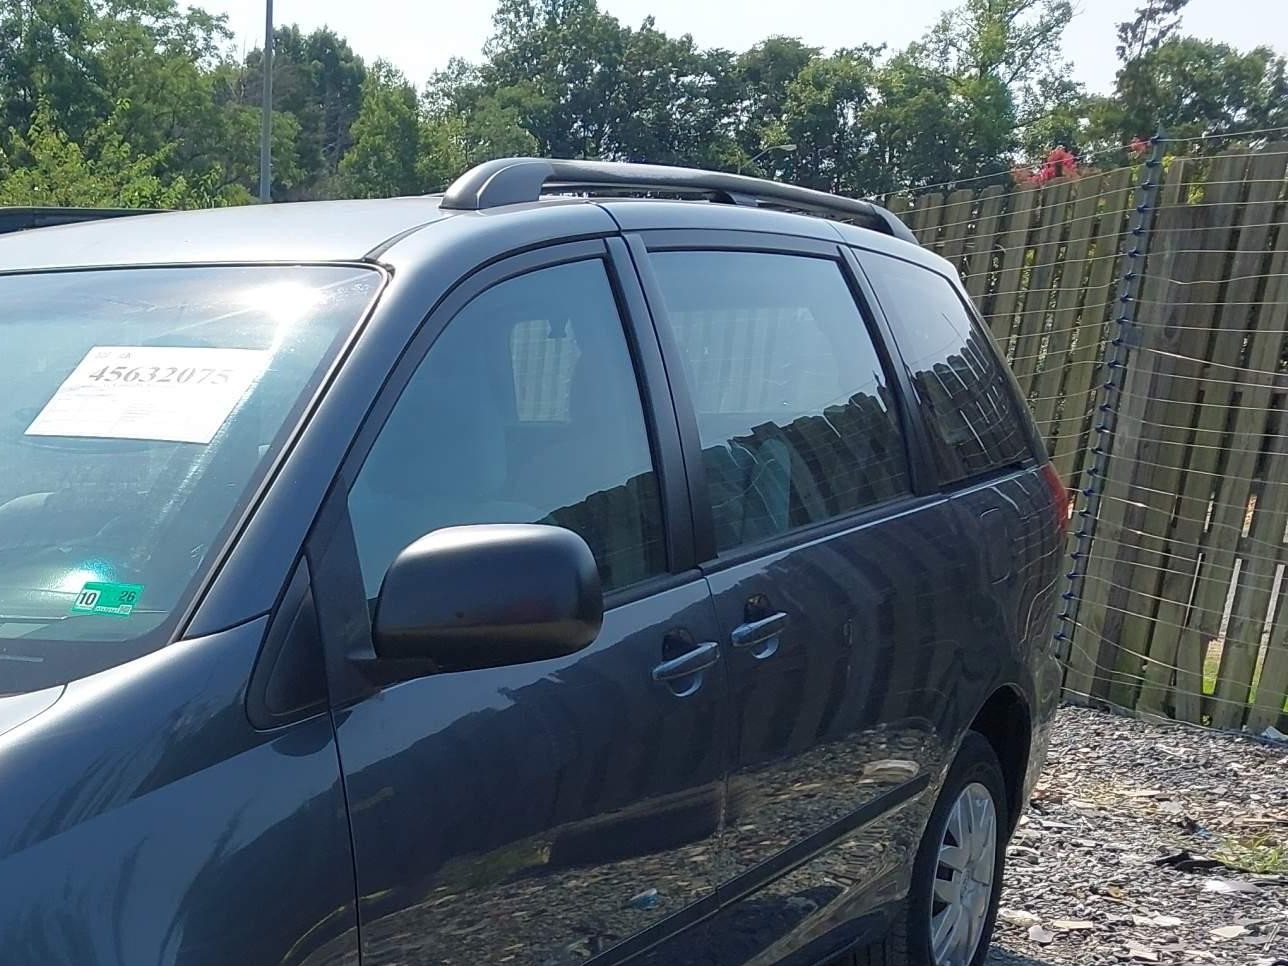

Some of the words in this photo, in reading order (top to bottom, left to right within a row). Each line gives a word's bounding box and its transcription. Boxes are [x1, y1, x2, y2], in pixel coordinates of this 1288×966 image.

[88, 365, 236, 385] 45632075
[79, 591, 97, 605] 10
[119, 591, 137, 602] 26
